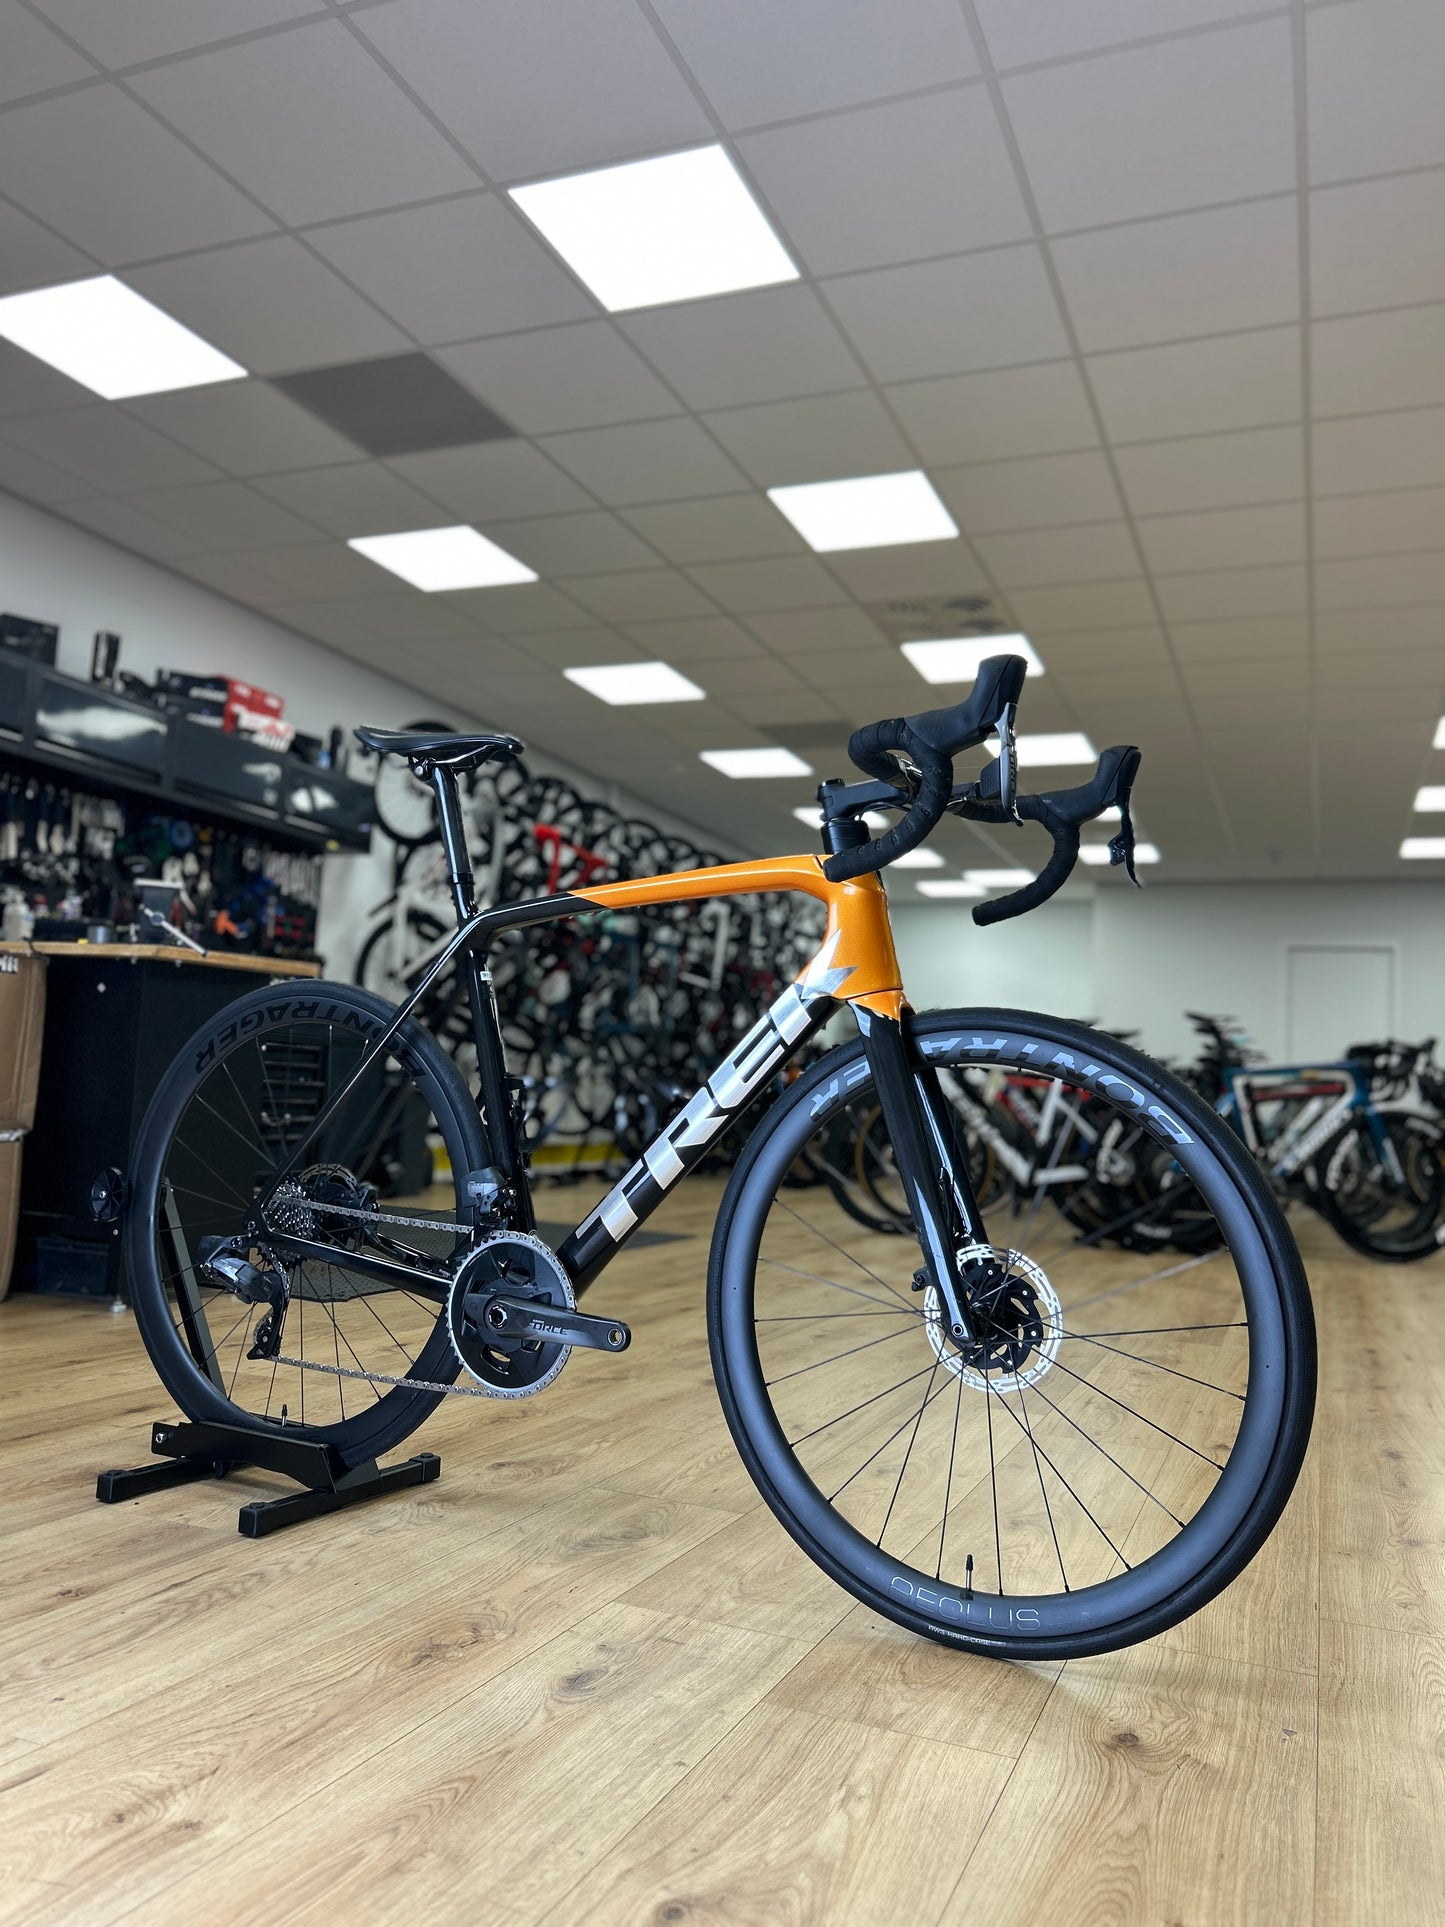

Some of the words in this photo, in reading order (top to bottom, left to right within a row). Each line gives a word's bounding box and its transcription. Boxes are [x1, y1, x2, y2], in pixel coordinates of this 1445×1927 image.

[575, 928, 859, 1242] TREK
[810, 1037, 1196, 1145] BONTRAER
[888, 1576, 1040, 1631] AEOLUS
